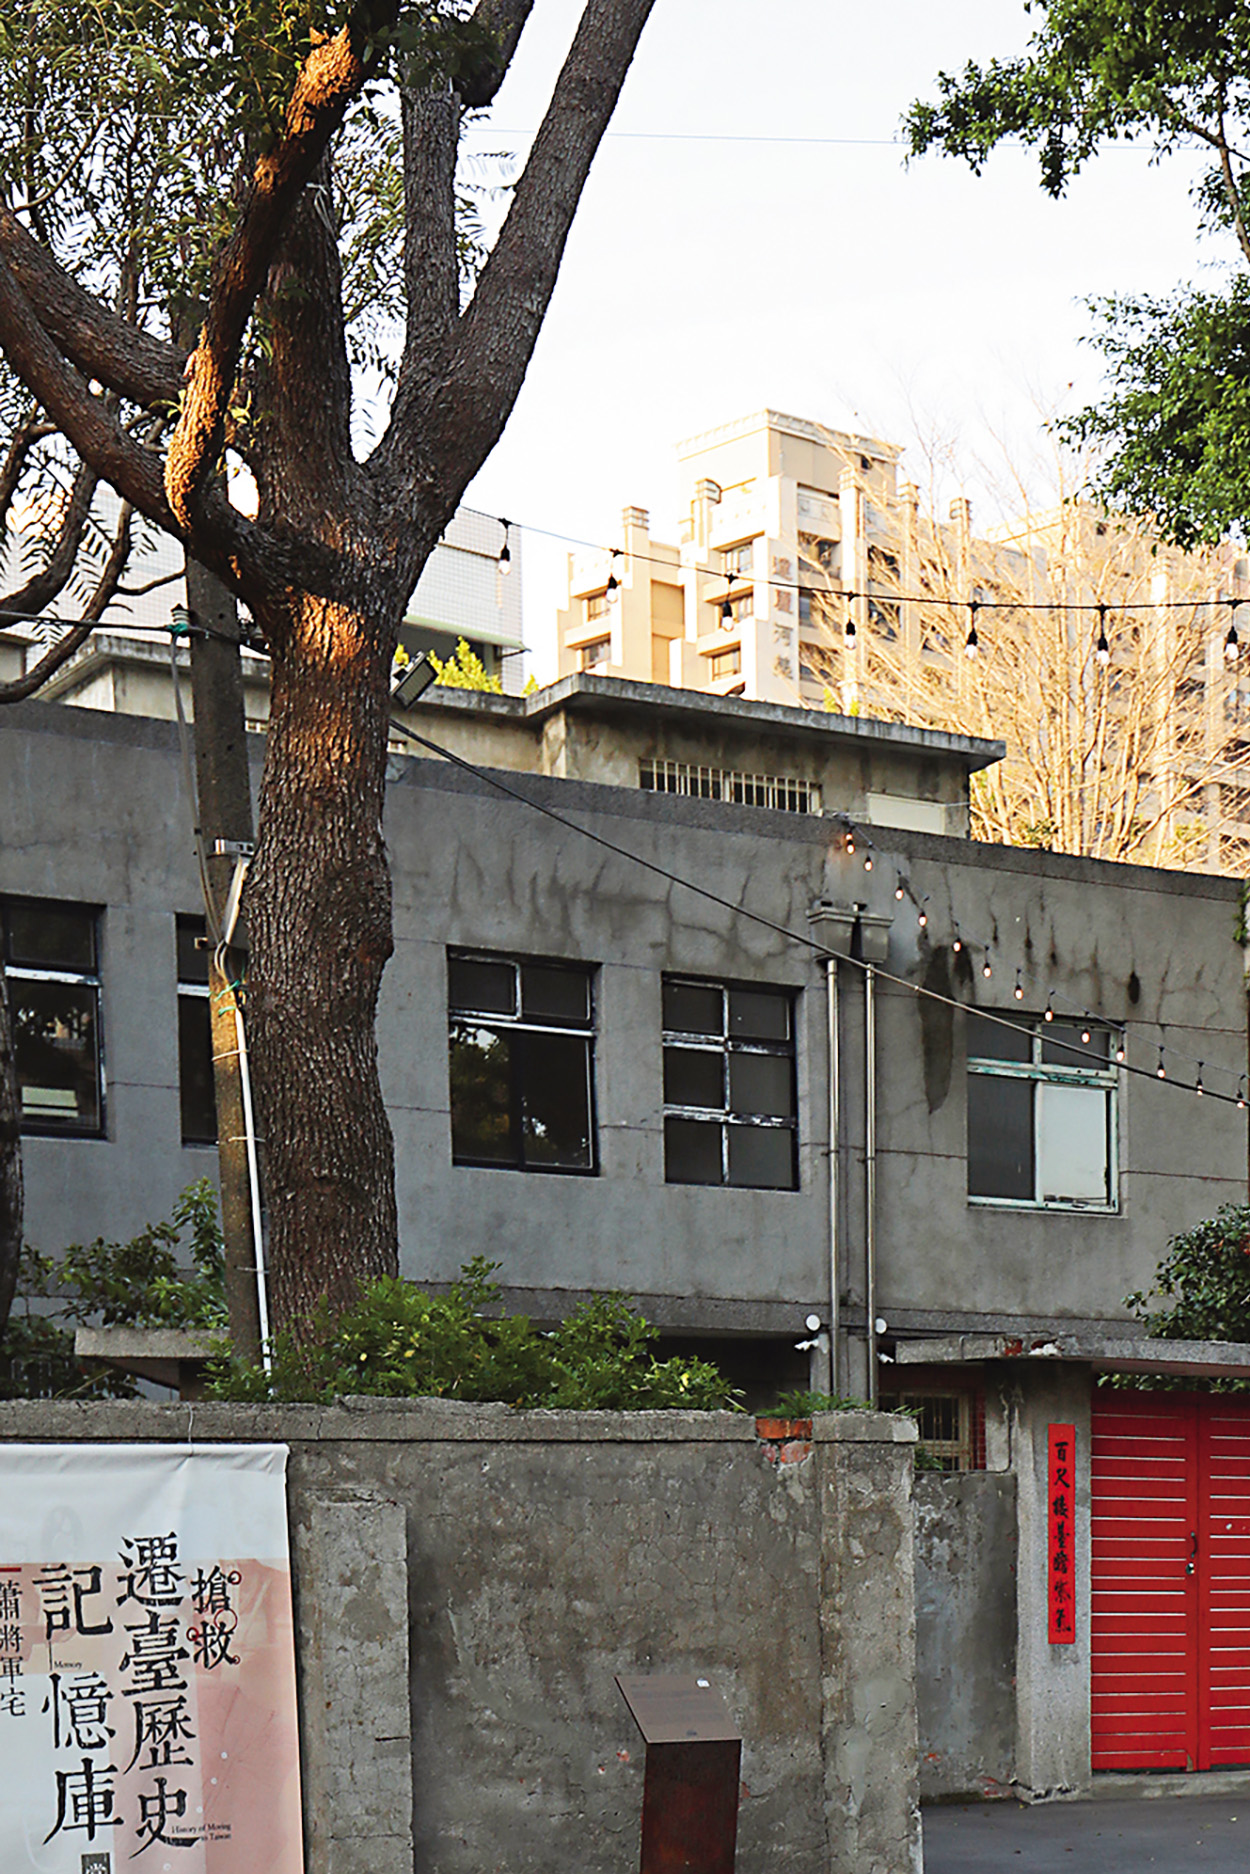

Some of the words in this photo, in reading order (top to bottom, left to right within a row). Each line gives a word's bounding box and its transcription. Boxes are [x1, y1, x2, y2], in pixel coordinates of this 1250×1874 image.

[32, 1563, 124, 1845] 記憶庫
[116, 1530, 201, 1861] 遷臺歷史
[189, 1565, 240, 1670] 搶救
